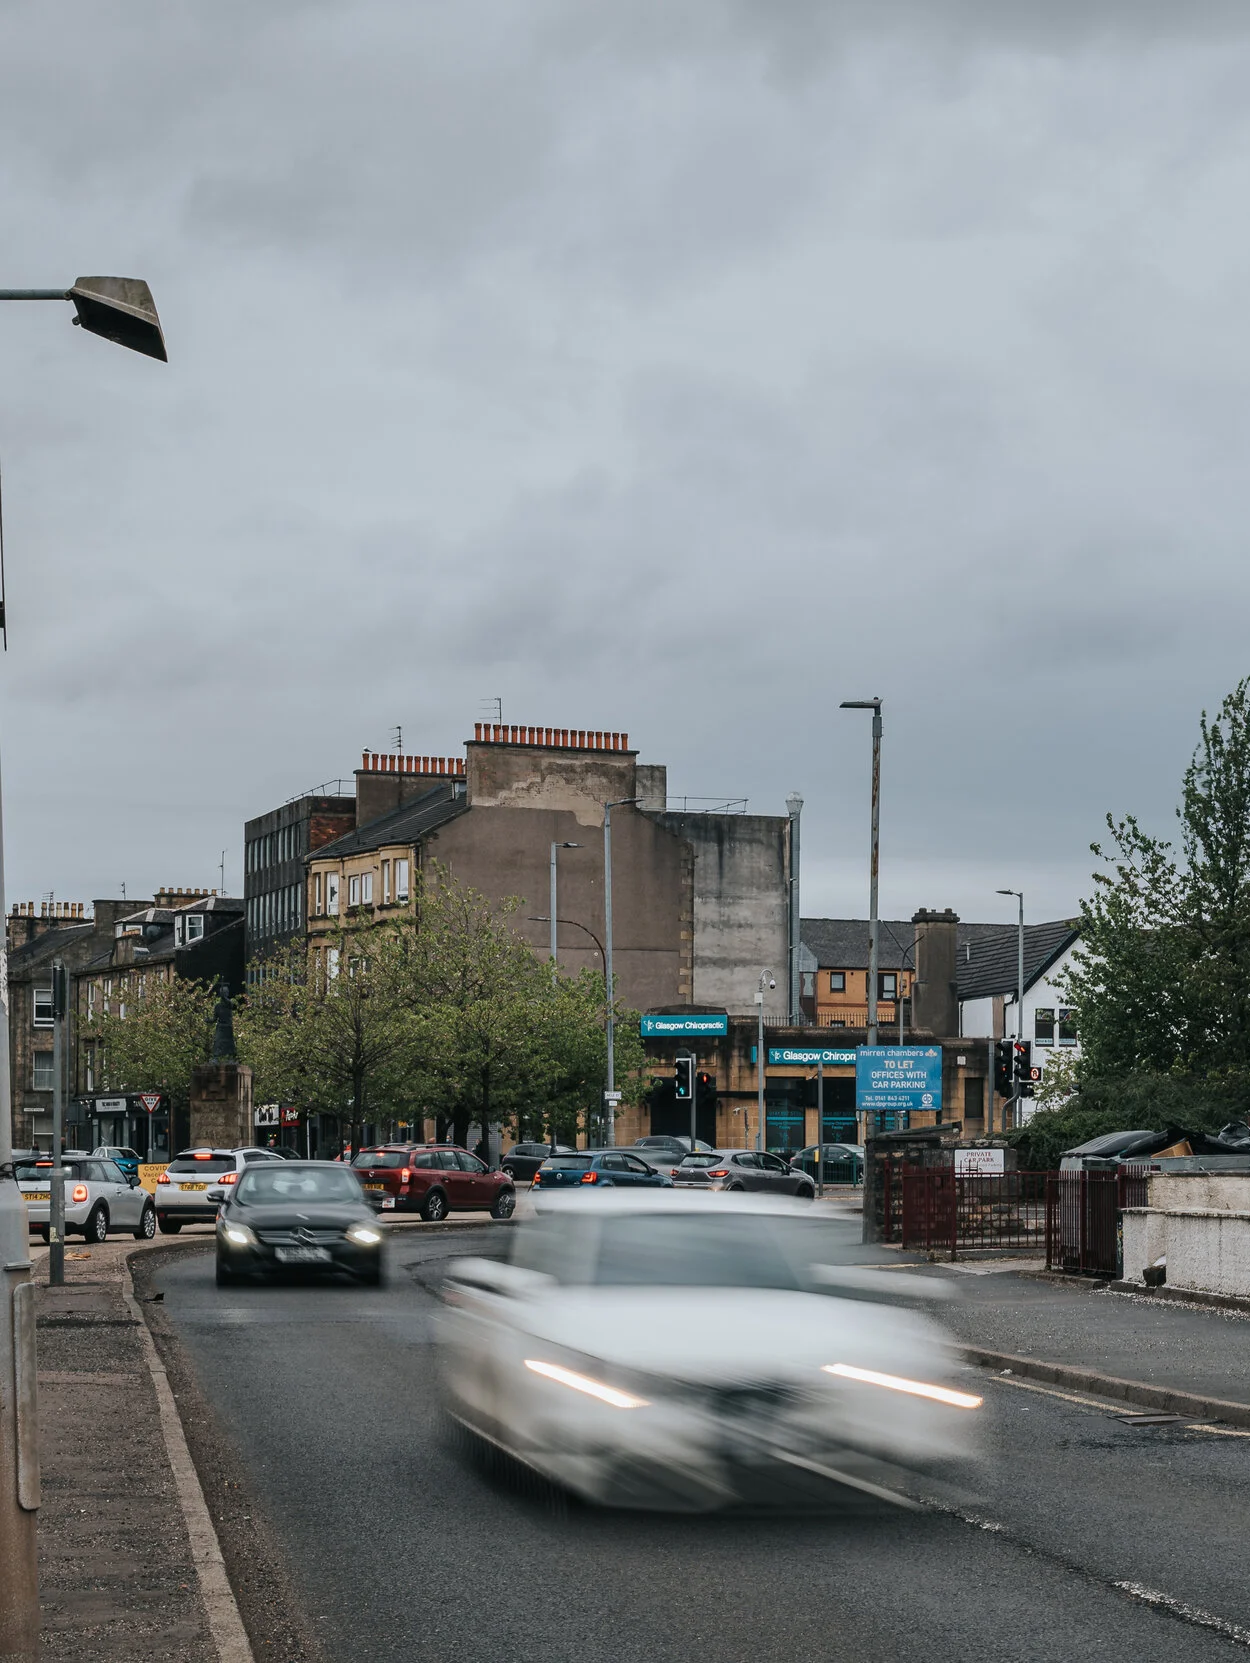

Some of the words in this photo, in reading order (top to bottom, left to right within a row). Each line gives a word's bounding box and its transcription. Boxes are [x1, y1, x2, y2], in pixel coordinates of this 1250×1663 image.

[656, 1021, 684, 1030] Glasgow
[685, 1021, 724, 1030] Chiropractic
[782, 1051, 822, 1062] Glasgow
[822, 1051, 856, 1062] Chiropra
[884, 1060, 896, 1068] TO
[898, 1060, 914, 1068] LET
